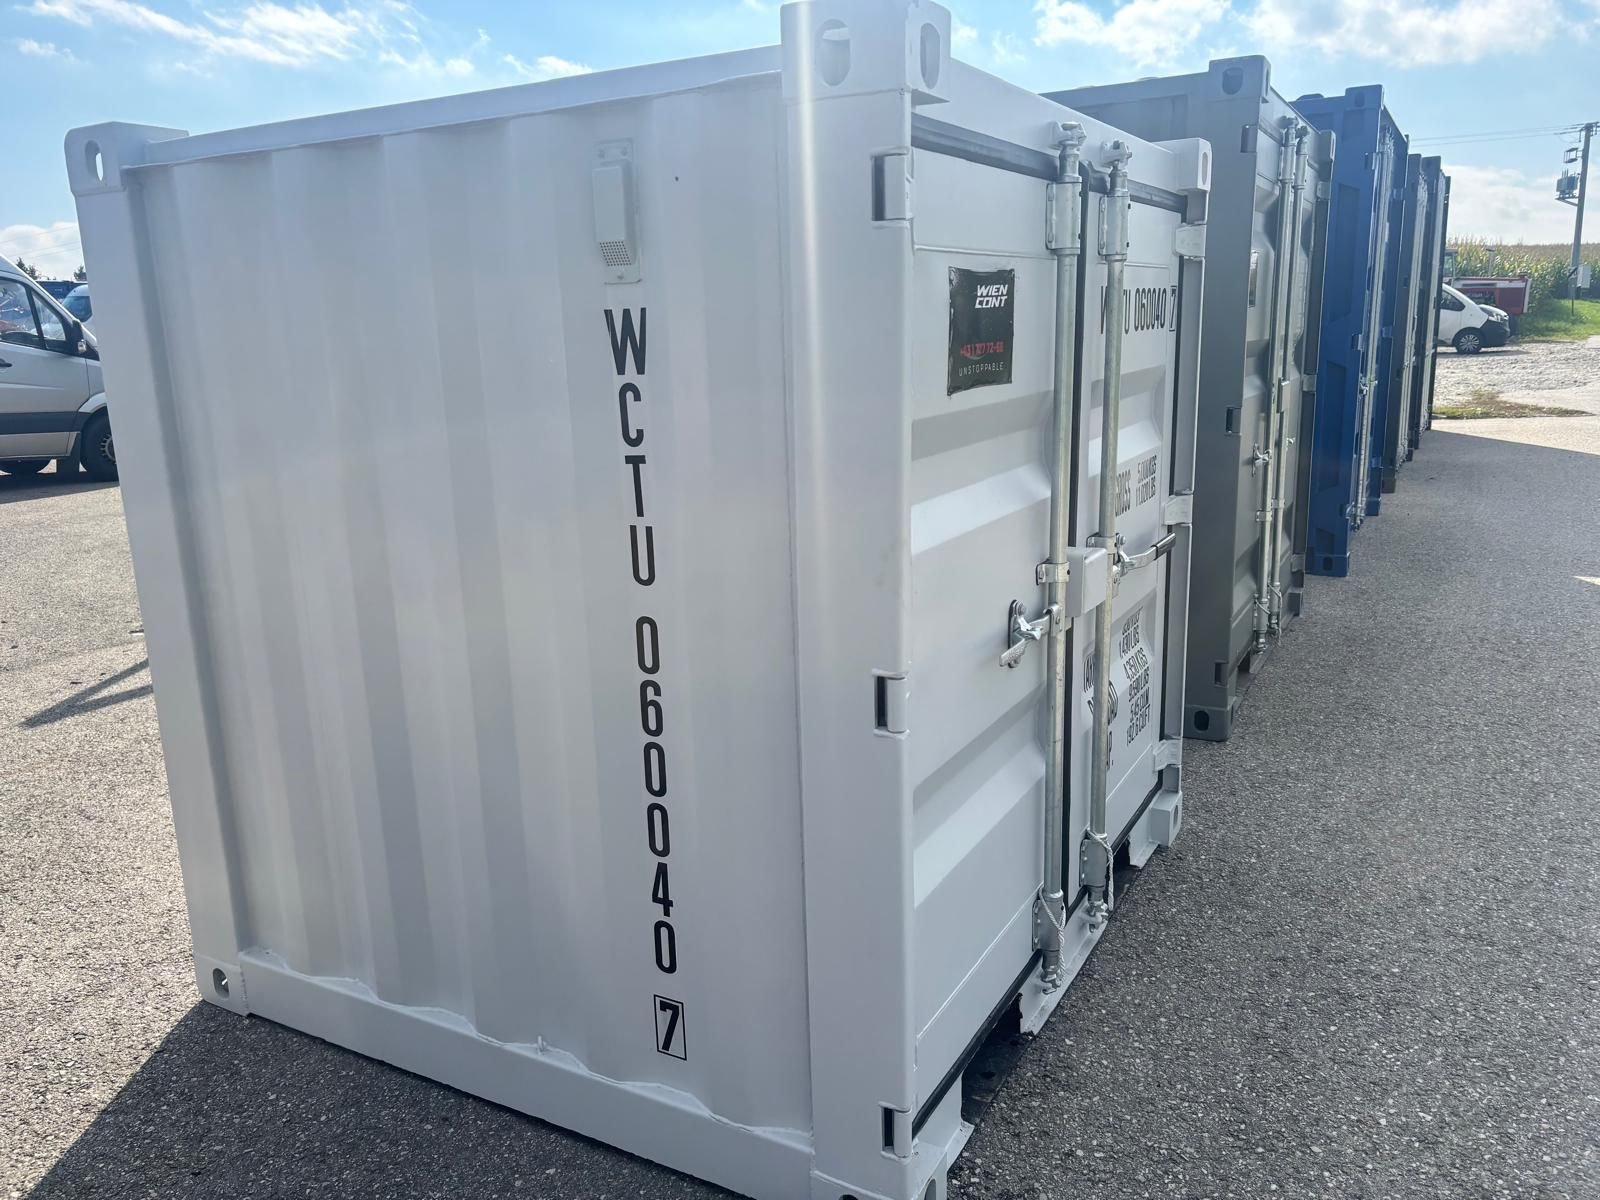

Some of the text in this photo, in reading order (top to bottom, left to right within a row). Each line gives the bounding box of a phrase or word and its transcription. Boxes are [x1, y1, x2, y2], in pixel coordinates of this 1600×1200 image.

[976, 284, 1009, 296] WIEN
[974, 296, 1008, 308] CONT
[1134, 287, 1167, 332] 060040
[1169, 286, 1177, 330] 7
[958, 361, 1004, 377] UNSTOPPABLE
[603, 307, 684, 1056] WCTU 060040 7
